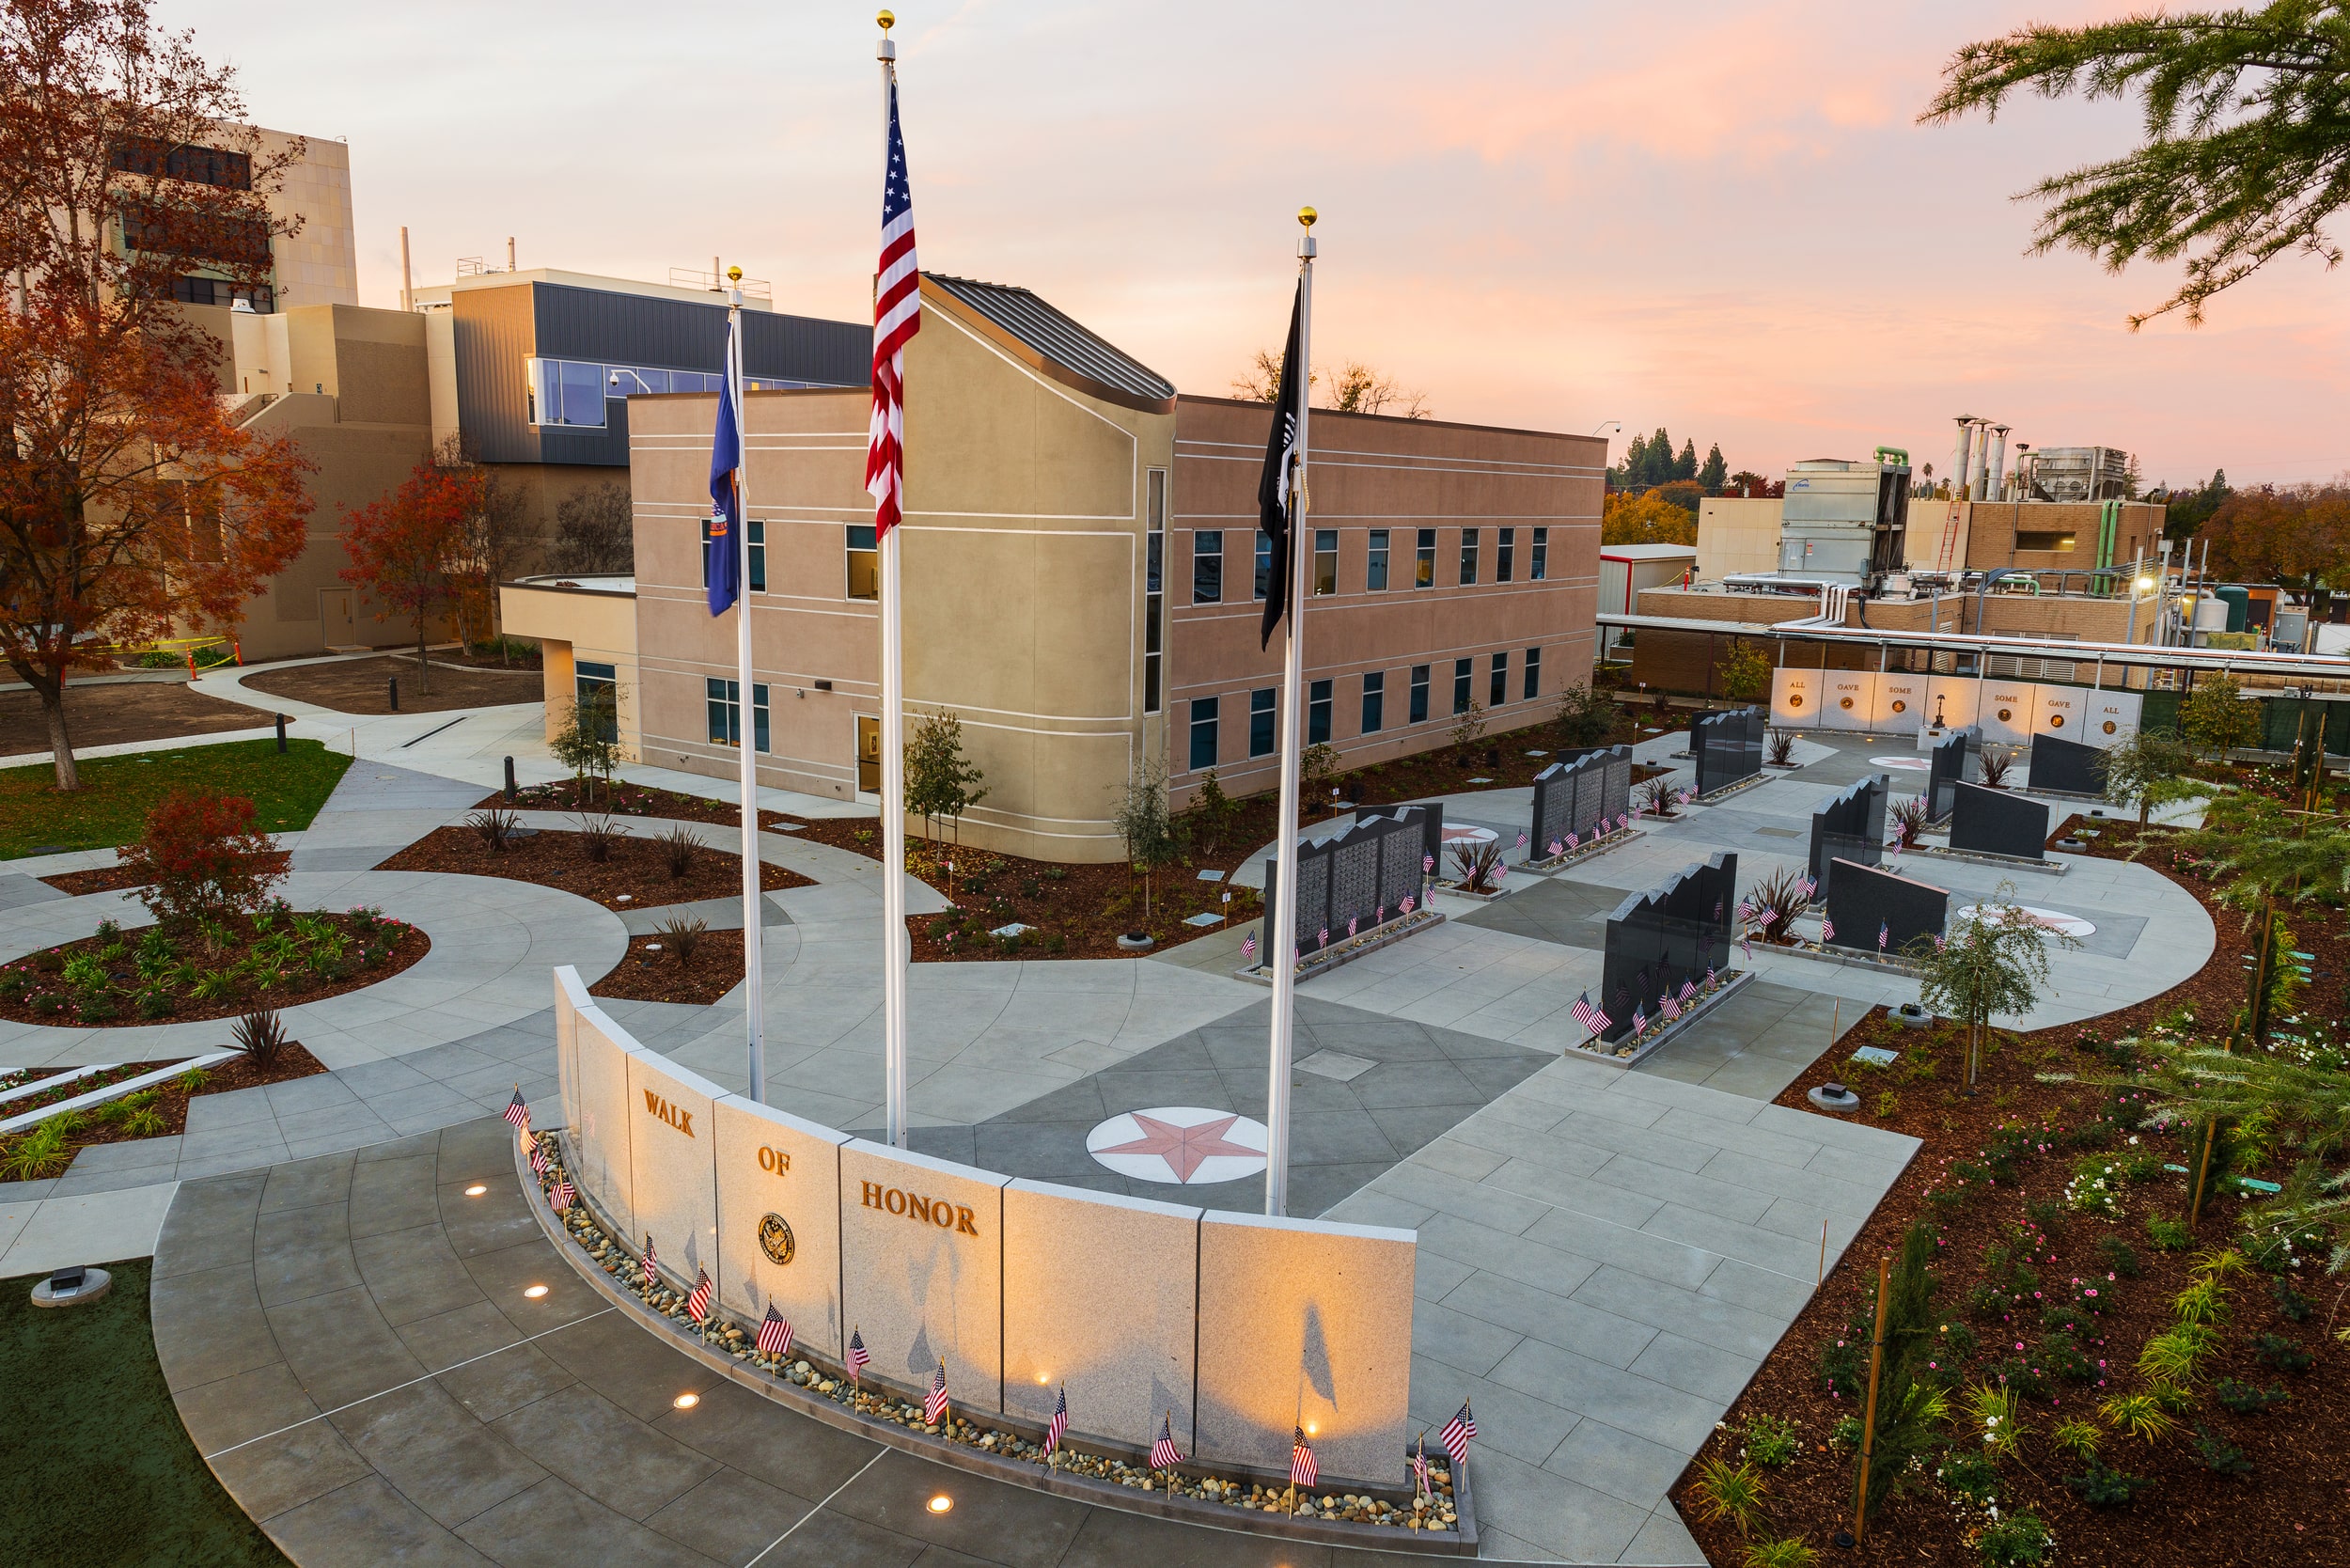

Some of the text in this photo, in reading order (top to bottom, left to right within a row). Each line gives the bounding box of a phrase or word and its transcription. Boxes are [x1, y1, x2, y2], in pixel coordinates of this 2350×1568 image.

[1888, 686, 1912, 695] SOME
[1994, 695, 2018, 703] SOME
[2048, 699, 2071, 708] GAVE
[643, 1088, 979, 1236] WALK OF HONOR
